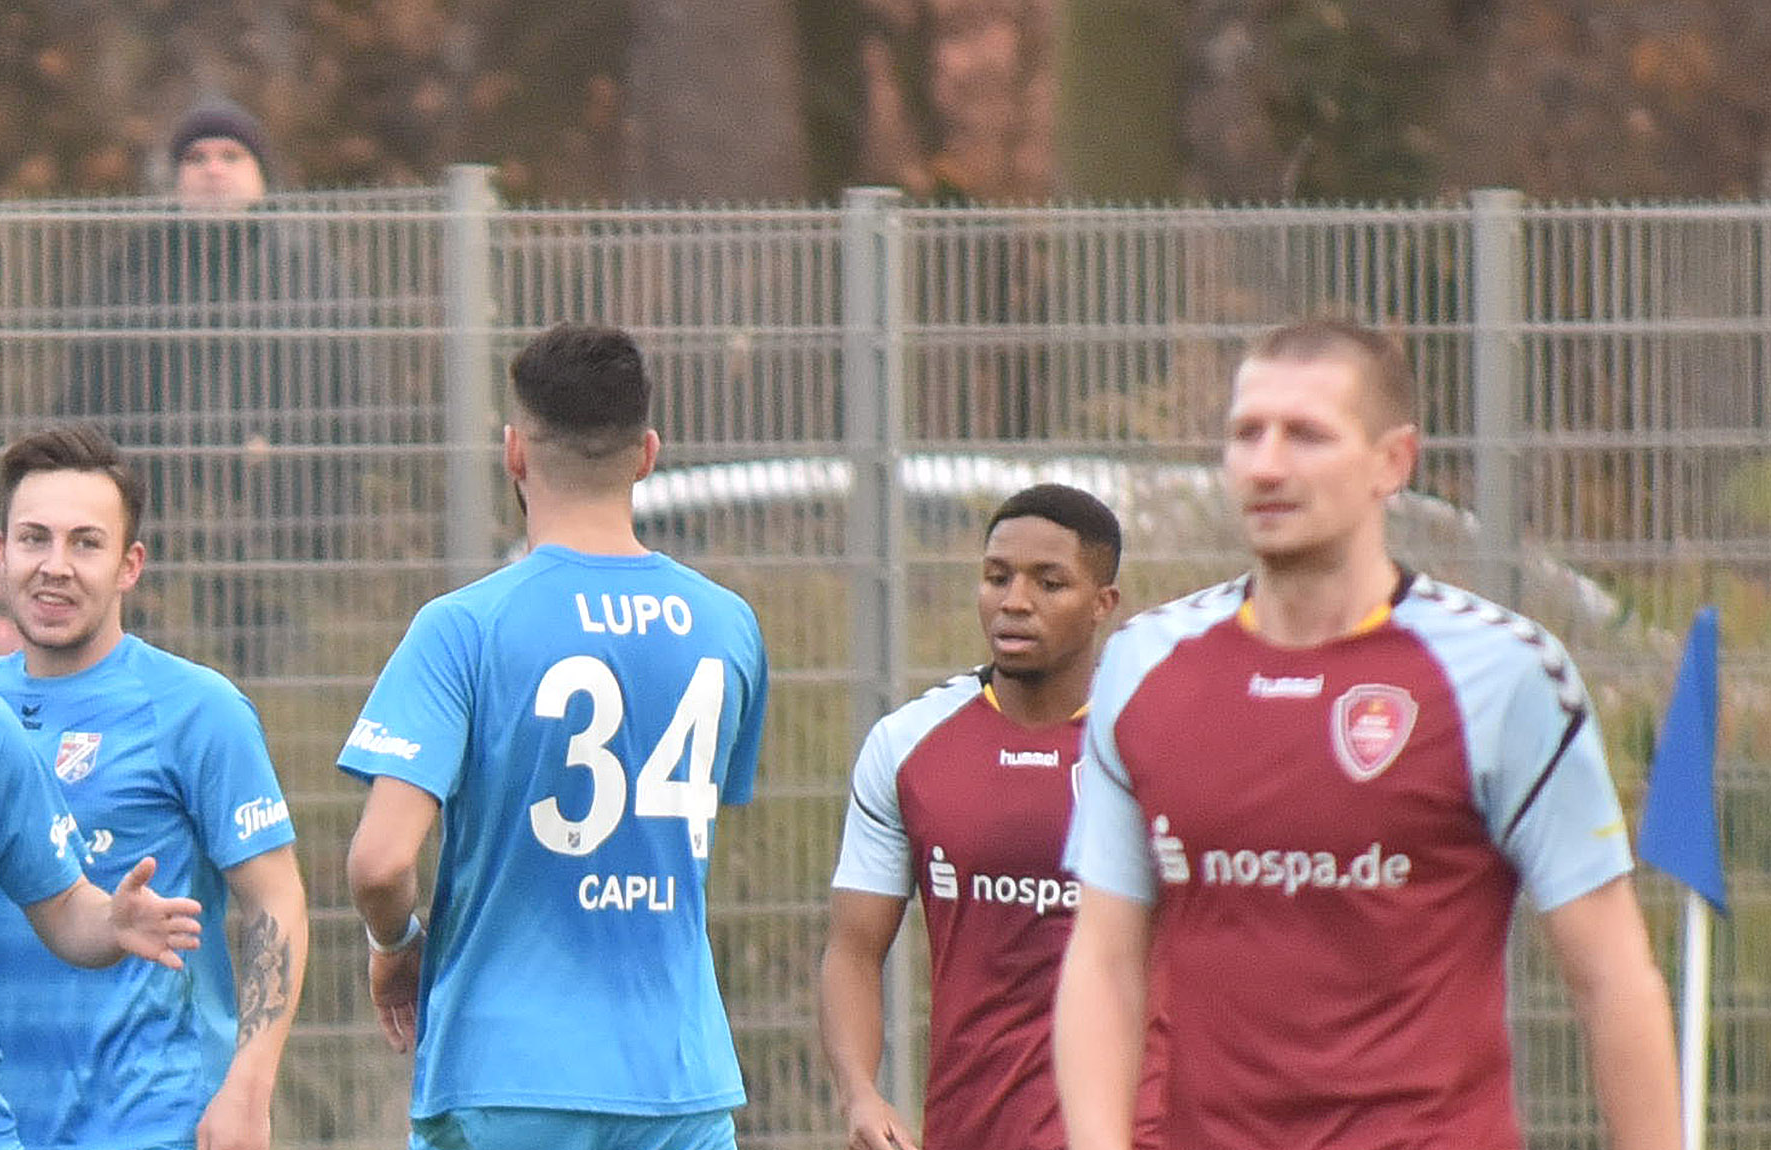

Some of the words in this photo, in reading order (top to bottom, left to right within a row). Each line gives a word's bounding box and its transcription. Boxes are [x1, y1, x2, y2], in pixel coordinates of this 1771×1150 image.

[575, 593, 693, 635] LUPO
[530, 655, 725, 858] 34
[578, 875, 675, 911] CAPLI
[1203, 842, 1412, 896] nospa.de
